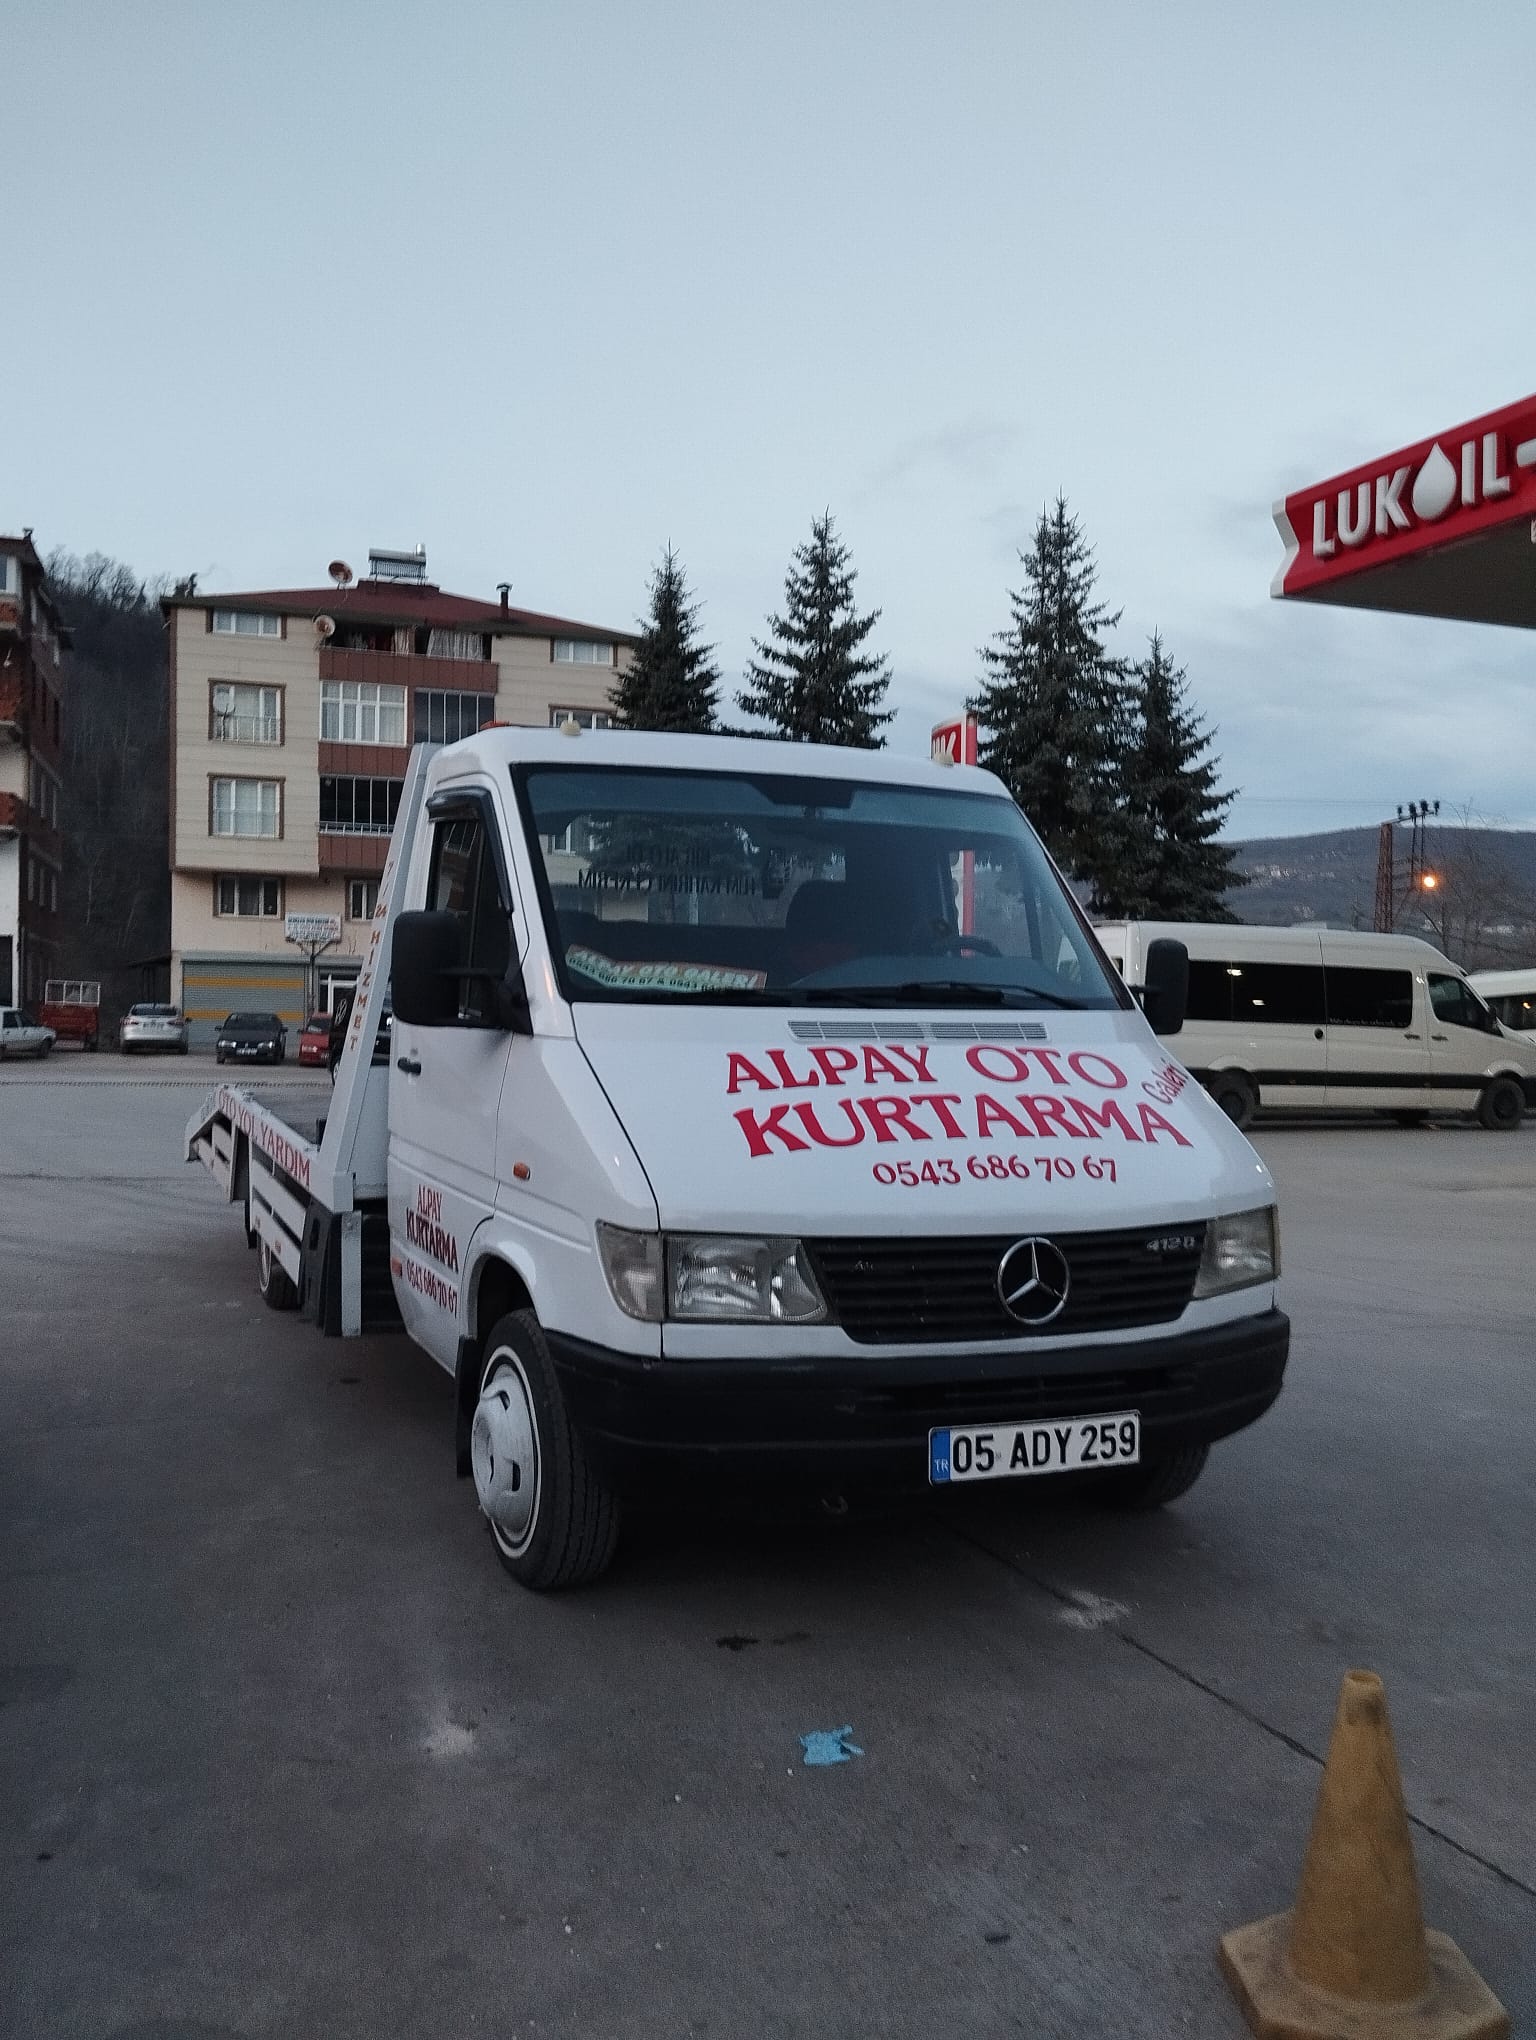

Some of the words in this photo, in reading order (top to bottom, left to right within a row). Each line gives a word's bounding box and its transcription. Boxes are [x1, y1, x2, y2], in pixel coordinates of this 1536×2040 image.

[726, 1044, 938, 1094] ALPAY
[966, 1045, 1129, 1089] OTO
[1141, 1057, 1189, 1105] Galeri
[733, 1093, 1195, 1157] KURTARMA
[261, 1121, 311, 1190] YARDIM
[872, 1159, 962, 1187] 0543
[966, 1154, 1031, 1181] 686
[1034, 1157, 1077, 1183] 70
[1081, 1155, 1118, 1183] 67
[417, 1183, 443, 1222] ALPAY
[406, 1206, 459, 1275] KURTARMA
[406, 1258, 423, 1294] 0543
[424, 1266, 437, 1301] 686
[448, 1284, 458, 1320] 67
[934, 1459, 949, 1474] TR
[952, 1432, 995, 1474] 05
[1009, 1425, 1072, 1469] ADY
[1080, 1419, 1136, 1463] 259
